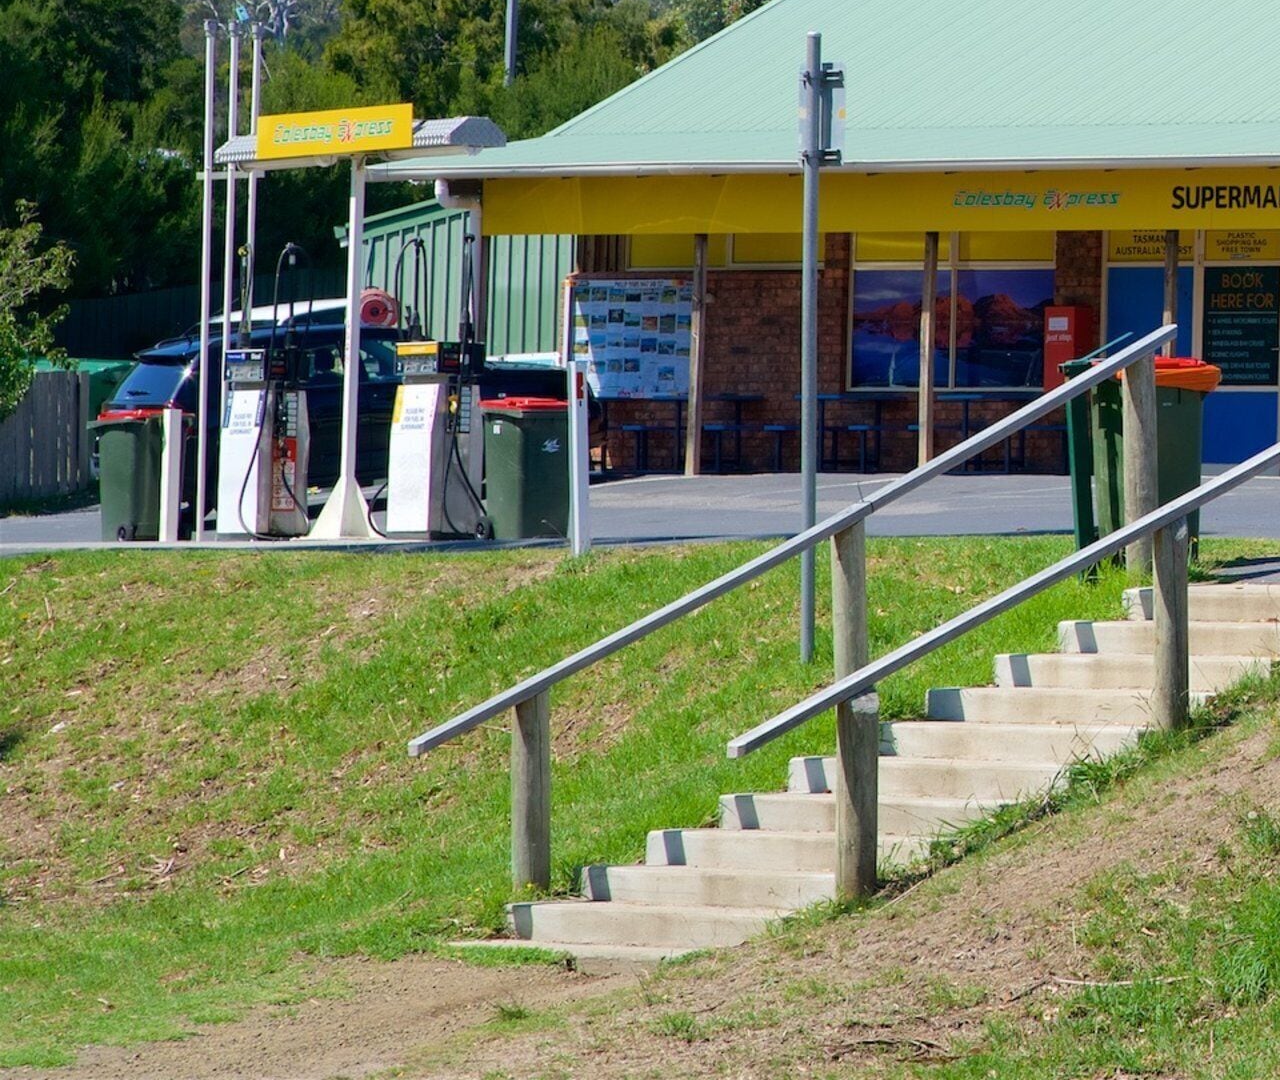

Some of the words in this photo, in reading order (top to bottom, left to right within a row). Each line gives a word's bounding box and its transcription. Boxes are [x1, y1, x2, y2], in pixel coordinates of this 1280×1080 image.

[274, 123, 333, 144] Colesbay
[337, 119, 393, 143] Express
[953, 190, 1037, 208] Colesbay
[1043, 189, 1121, 210] Express
[1222, 273, 1263, 288] BOOK
[1211, 293, 1245, 308] HERE
[1247, 293, 1274, 308] FOR
